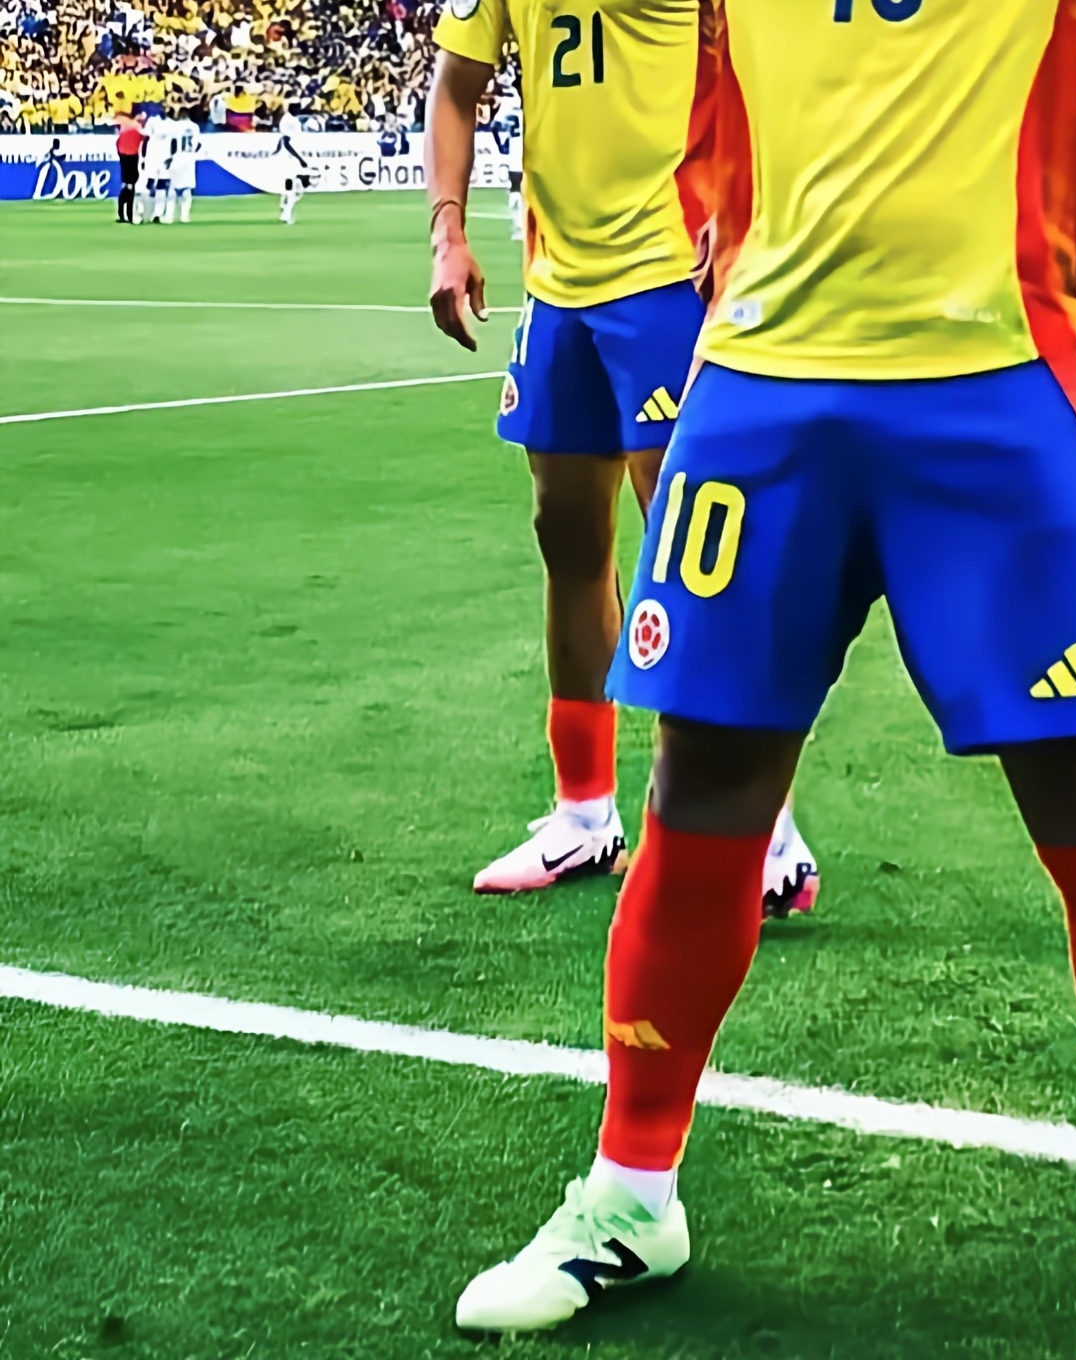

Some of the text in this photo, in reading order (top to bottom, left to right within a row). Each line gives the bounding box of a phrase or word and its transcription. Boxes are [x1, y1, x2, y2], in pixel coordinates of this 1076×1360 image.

[551, 10, 605, 88] 21
[32, 158, 111, 200] Dove
[652, 471, 746, 598] 10
